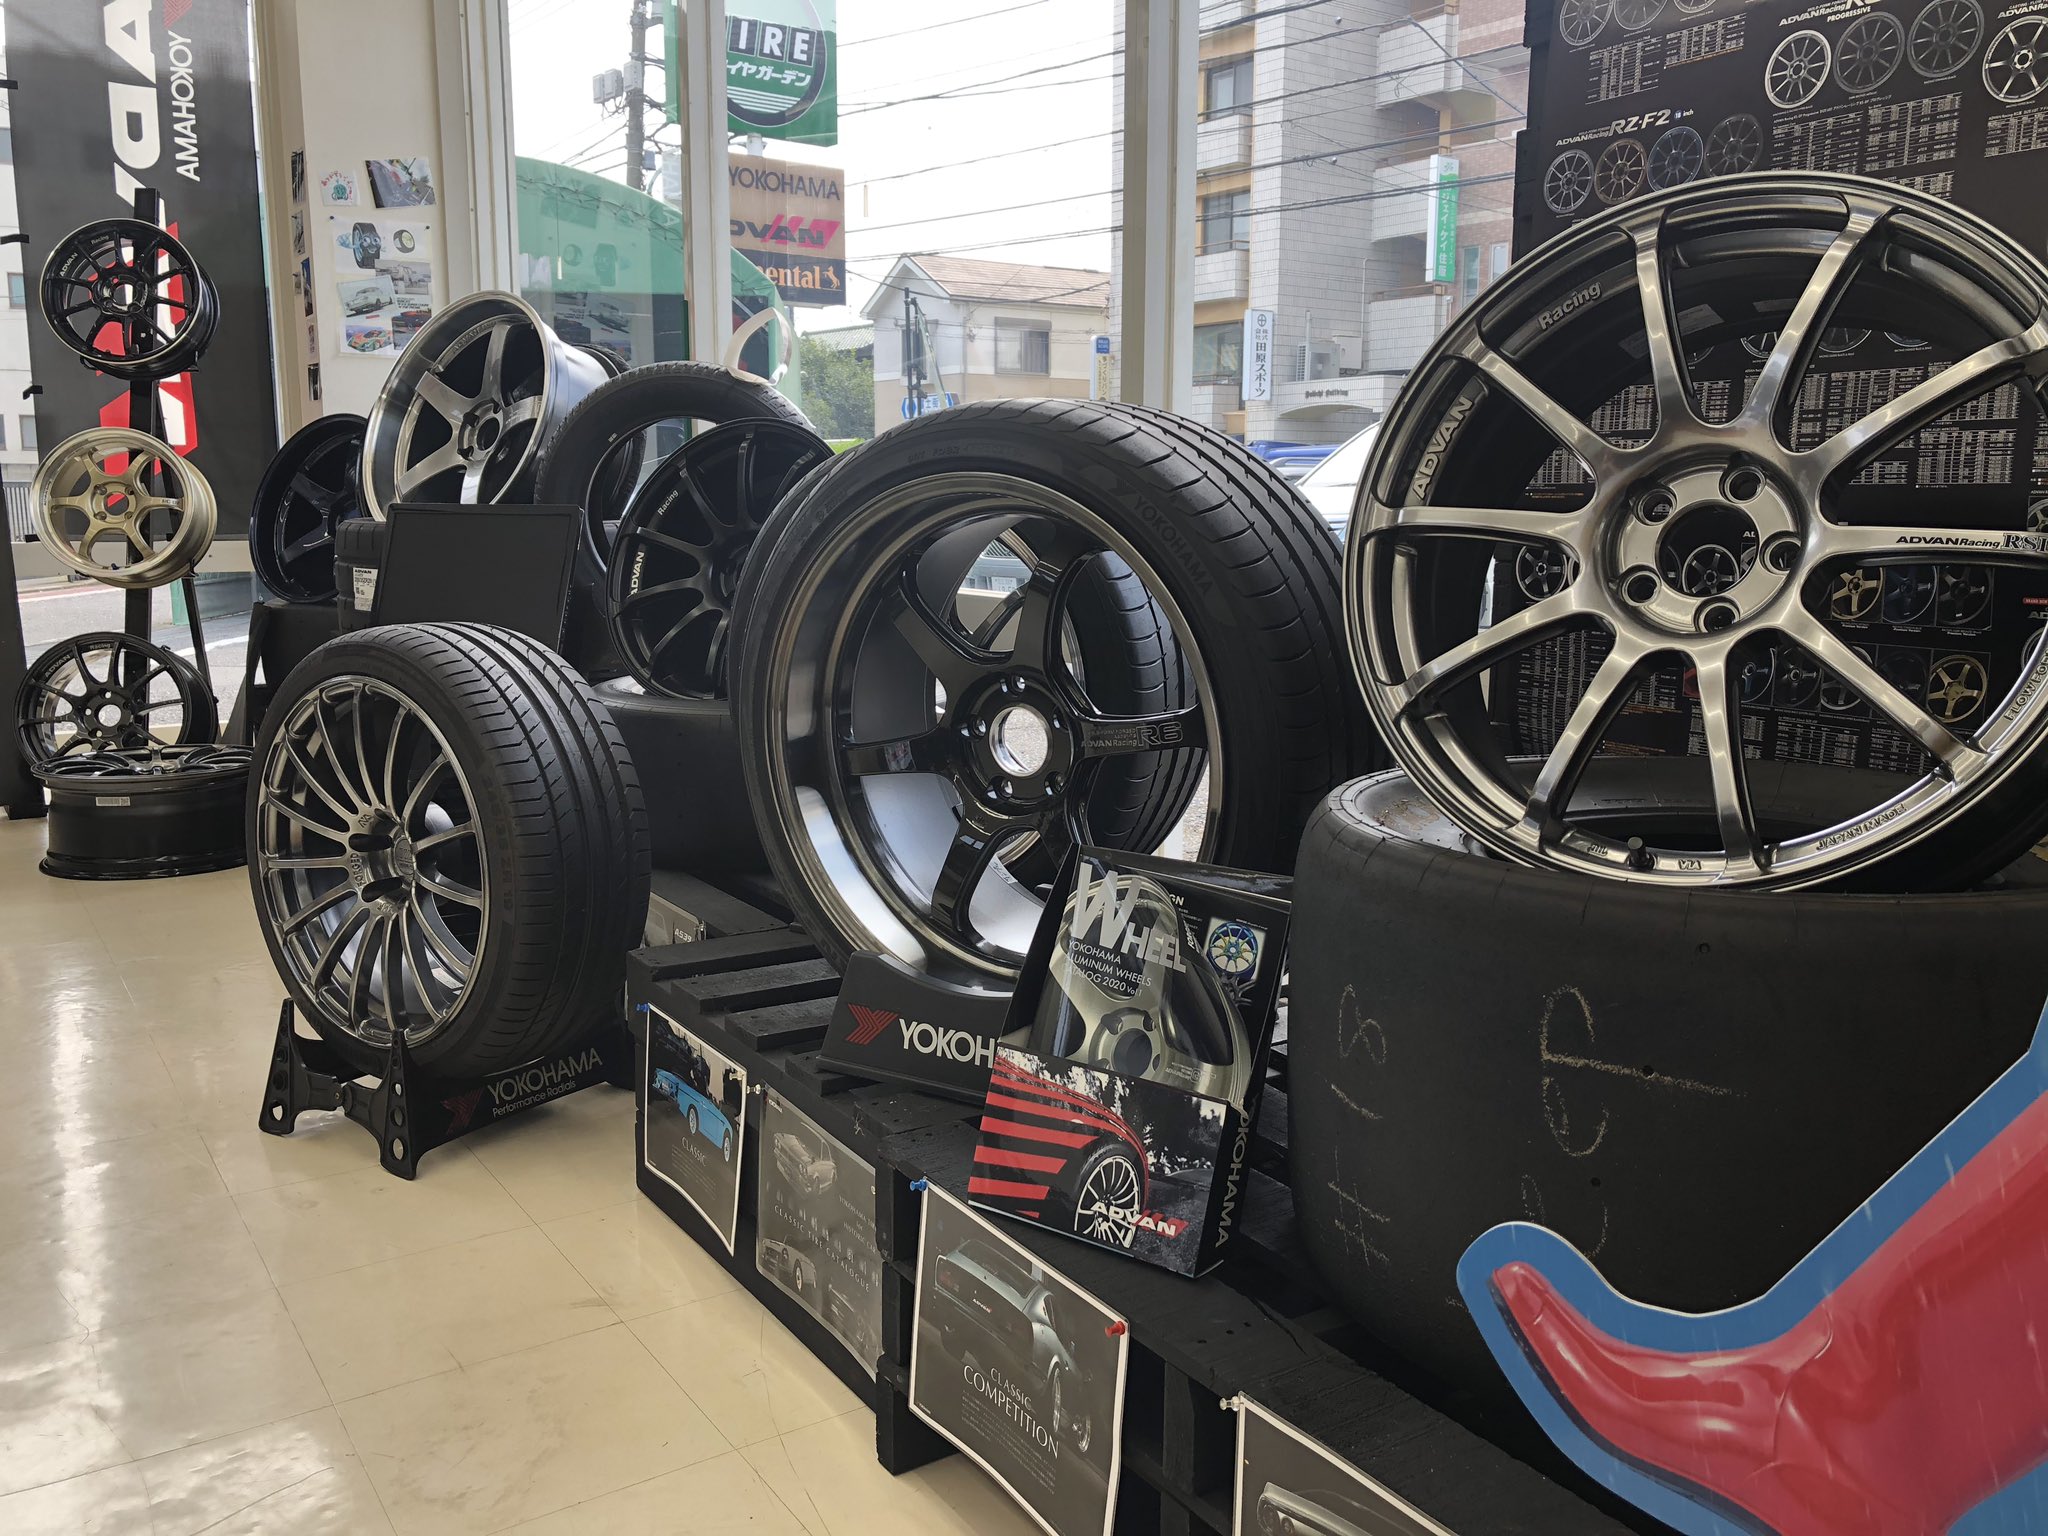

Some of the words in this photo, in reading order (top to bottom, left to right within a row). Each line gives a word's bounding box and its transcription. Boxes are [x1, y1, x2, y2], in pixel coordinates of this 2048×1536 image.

[1827, 6, 1871, 22] PROGRESSIVE
[738, 20, 811, 62] IRE
[1556, 135, 1589, 146] ADVAN
[729, 165, 841, 201] YOKOHAMA
[730, 219, 825, 246] DVAN
[60, 252, 79, 278] ADVAN
[1537, 282, 1603, 331] Racing
[1254, 341, 1267, 398] 田原スポーツ
[1412, 396, 1474, 500] ADVAN
[657, 489, 680, 516] Racing
[1896, 536, 1959, 546] ADVAN
[1958, 538, 2001, 549] Racing
[627, 551, 645, 599] ADVAN
[44, 654, 72, 678] ADVAN
[1136, 721, 1183, 746] R6
[1865, 802, 1909, 830] MADE
[1816, 825, 1864, 851] JAPAN
[1071, 862, 1187, 974] WHEEL
[1066, 951, 1117, 979] ALUMINUM
[1115, 967, 1152, 987] WHEELS
[1068, 938, 1122, 965] YOKOHAMA
[1102, 976, 1127, 991] 2020
[899, 1018, 996, 1069] YOKOH
[487, 1047, 603, 1105] YOKOHAMA
[492, 1092, 547, 1119] Performance
[546, 1079, 577, 1100] Radials
[681, 1136, 708, 1167] CLASSIC
[1215, 1112, 1250, 1248] OKOHAMA
[1090, 1201, 1177, 1236] ADVAN
[774, 1205, 805, 1233] CLASSIC
[807, 1230, 823, 1249] TIRE
[826, 1247, 870, 1293] CATALOGUE
[990, 1367, 1033, 1411] CLASSIC
[963, 1365, 1060, 1459] COMPETITION
